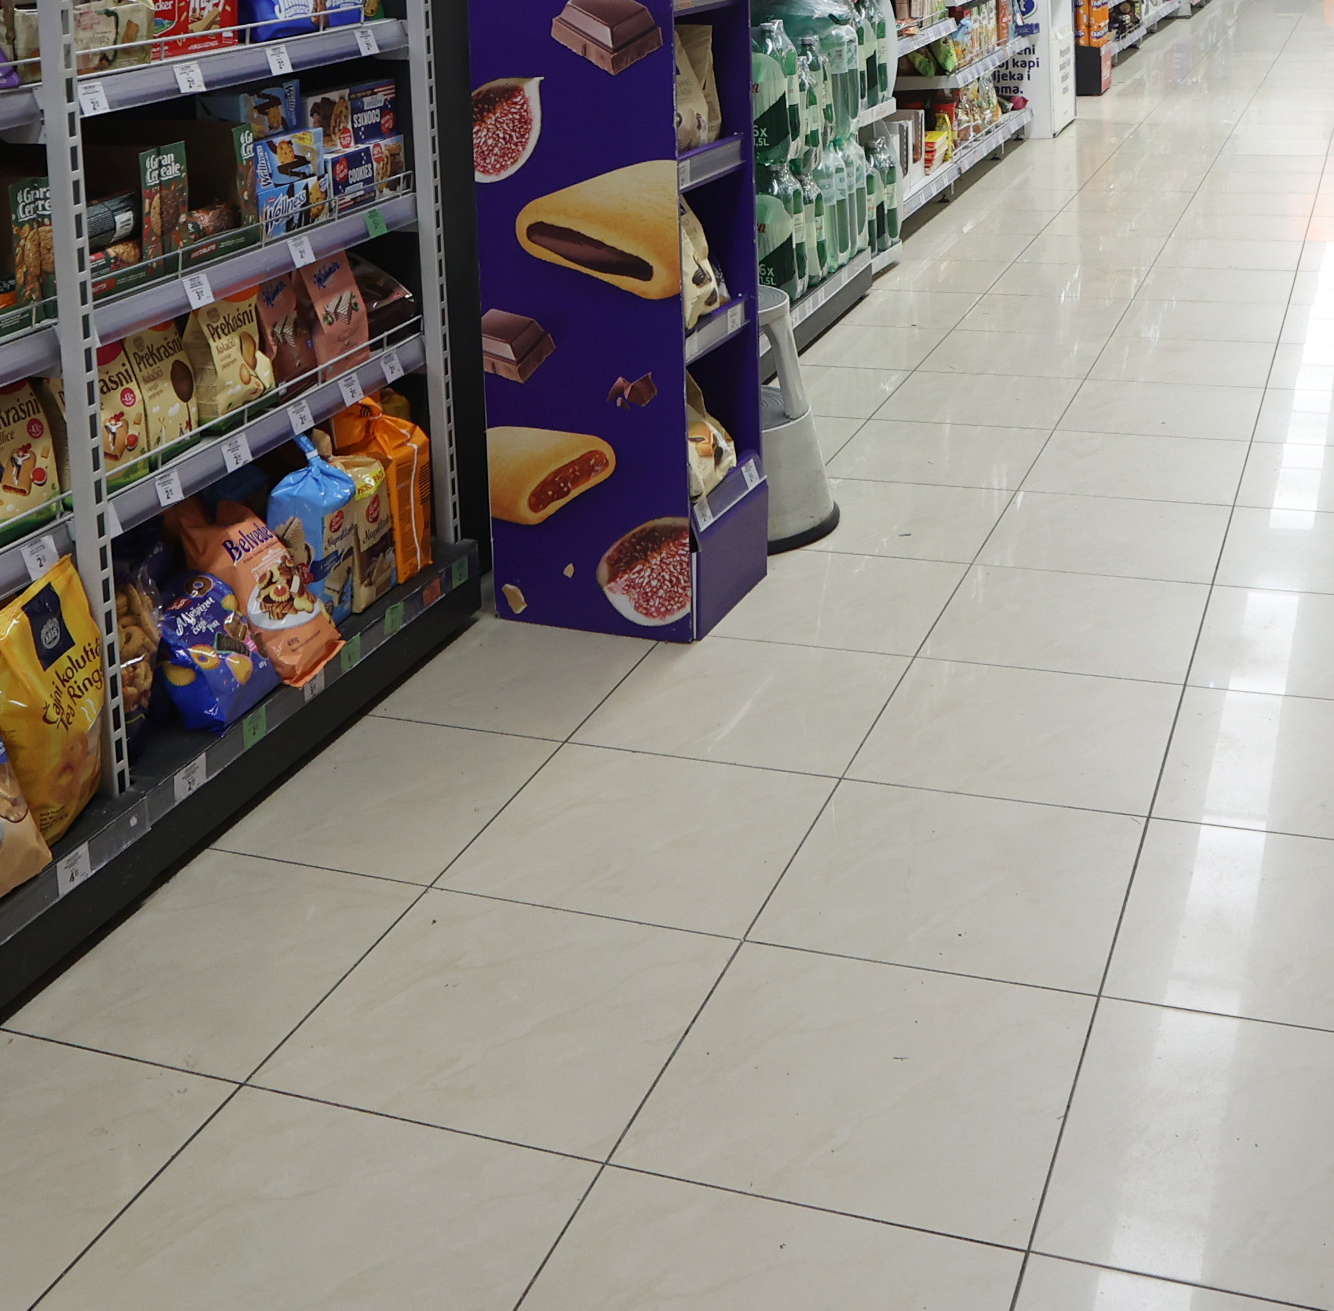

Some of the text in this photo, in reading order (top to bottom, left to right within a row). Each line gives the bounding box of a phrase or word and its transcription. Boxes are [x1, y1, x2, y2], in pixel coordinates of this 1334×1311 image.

[1013, 58, 1039, 70] kapi
[1027, 71, 1030, 81] i
[353, 110, 381, 128] COOKIES
[149, 153, 176, 172] Gran
[255, 145, 271, 188] Wellness
[347, 163, 374, 184] COOKIES
[265, 191, 307, 228] Wellness
[133, 333, 183, 373] PreKrašni
[41, 681, 66, 726] Čajni
[56, 706, 76, 732] Tea
